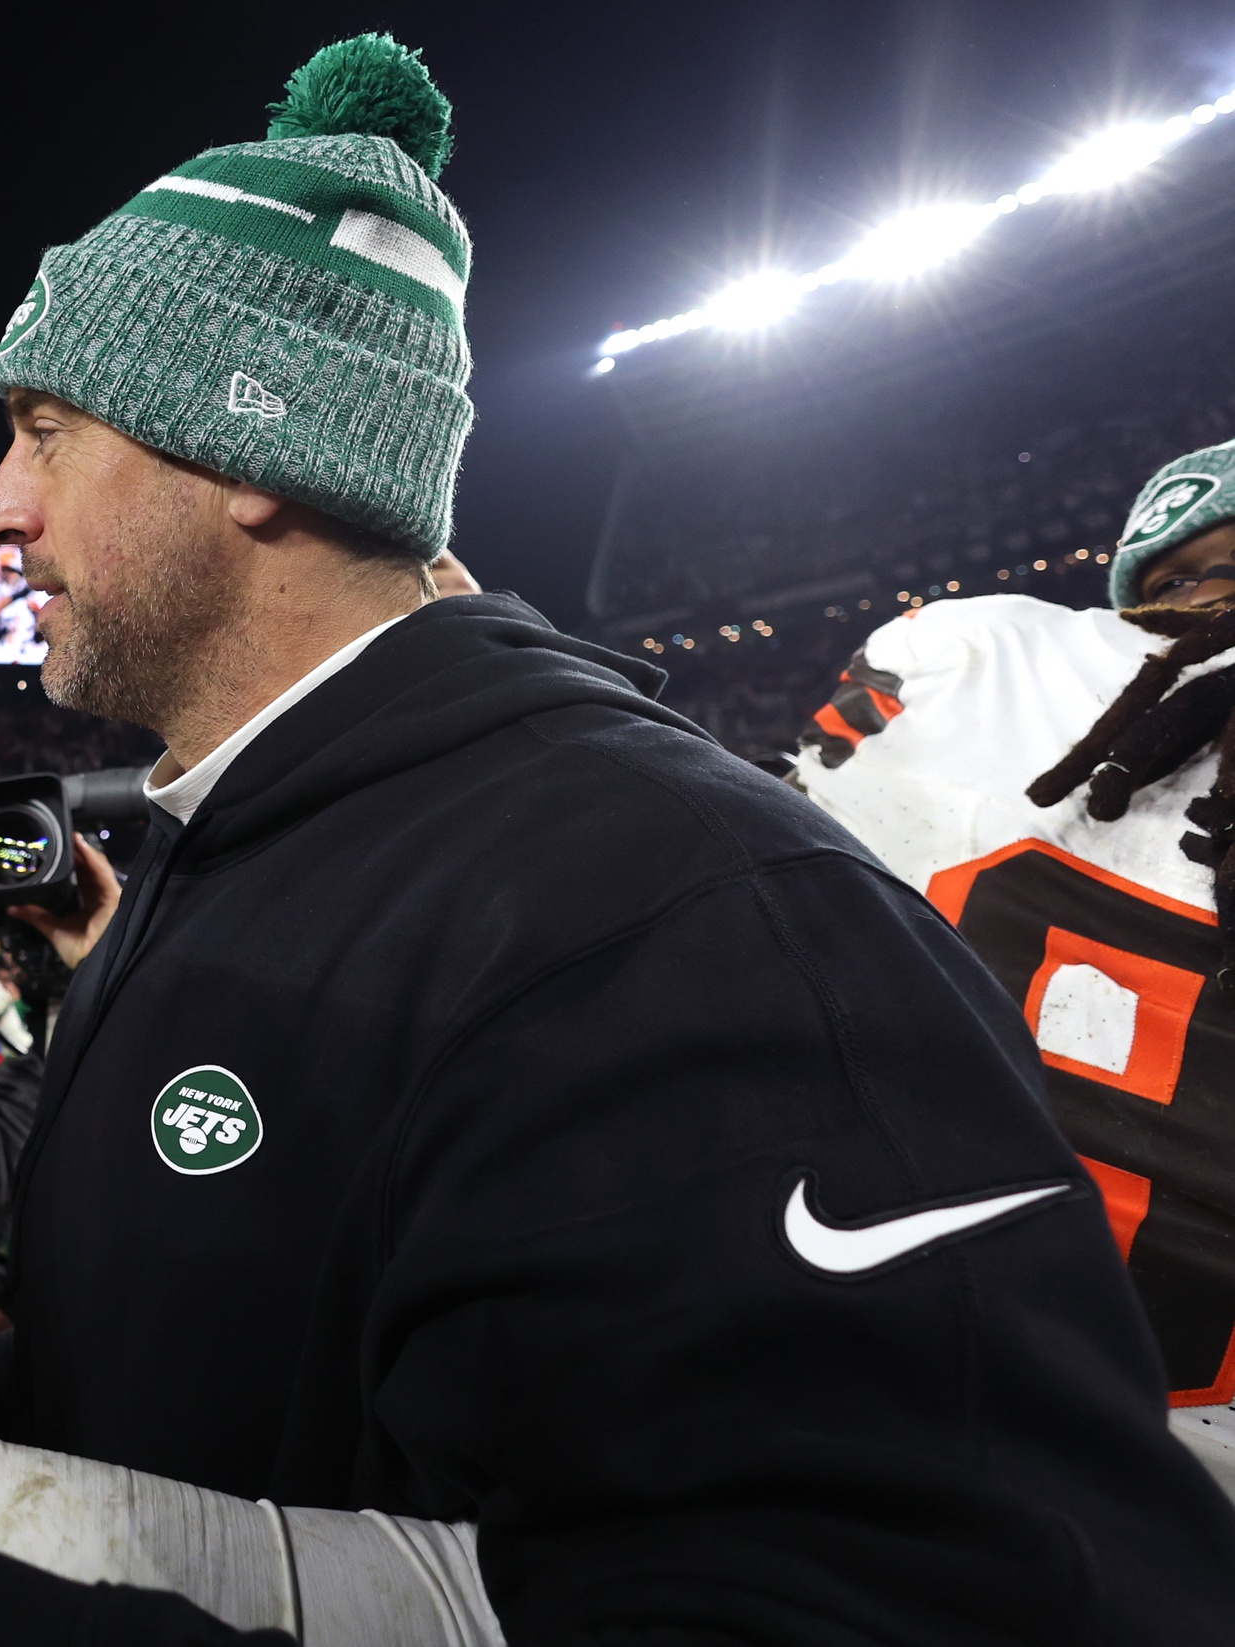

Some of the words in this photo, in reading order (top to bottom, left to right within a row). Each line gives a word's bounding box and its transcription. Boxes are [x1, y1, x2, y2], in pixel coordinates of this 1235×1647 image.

[178, 1086, 208, 1102] NEW
[206, 1093, 243, 1112] YORK
[162, 1103, 247, 1145] JETS
